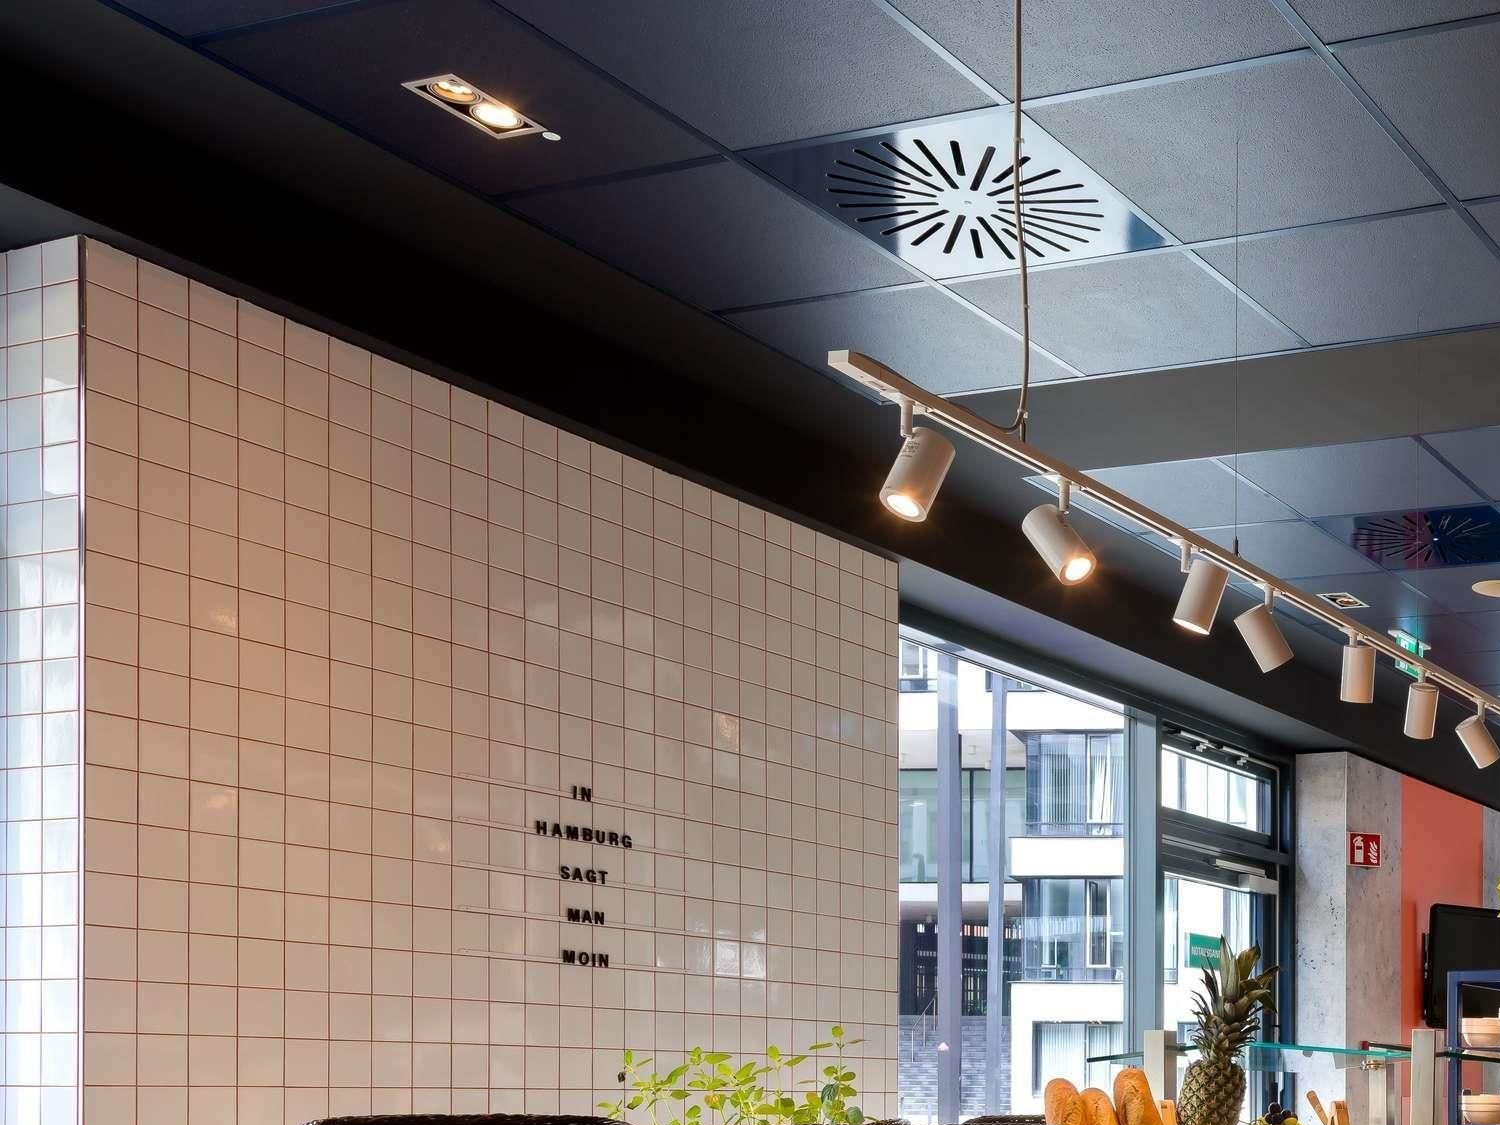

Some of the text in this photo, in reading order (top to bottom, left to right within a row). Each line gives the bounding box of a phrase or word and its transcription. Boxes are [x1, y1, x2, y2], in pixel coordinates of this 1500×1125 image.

[573, 785, 592, 802] IN
[536, 820, 633, 848] HAMBURG
[560, 866, 609, 885] SAGT
[567, 908, 605, 925] MAN
[562, 950, 609, 968] MOIN
